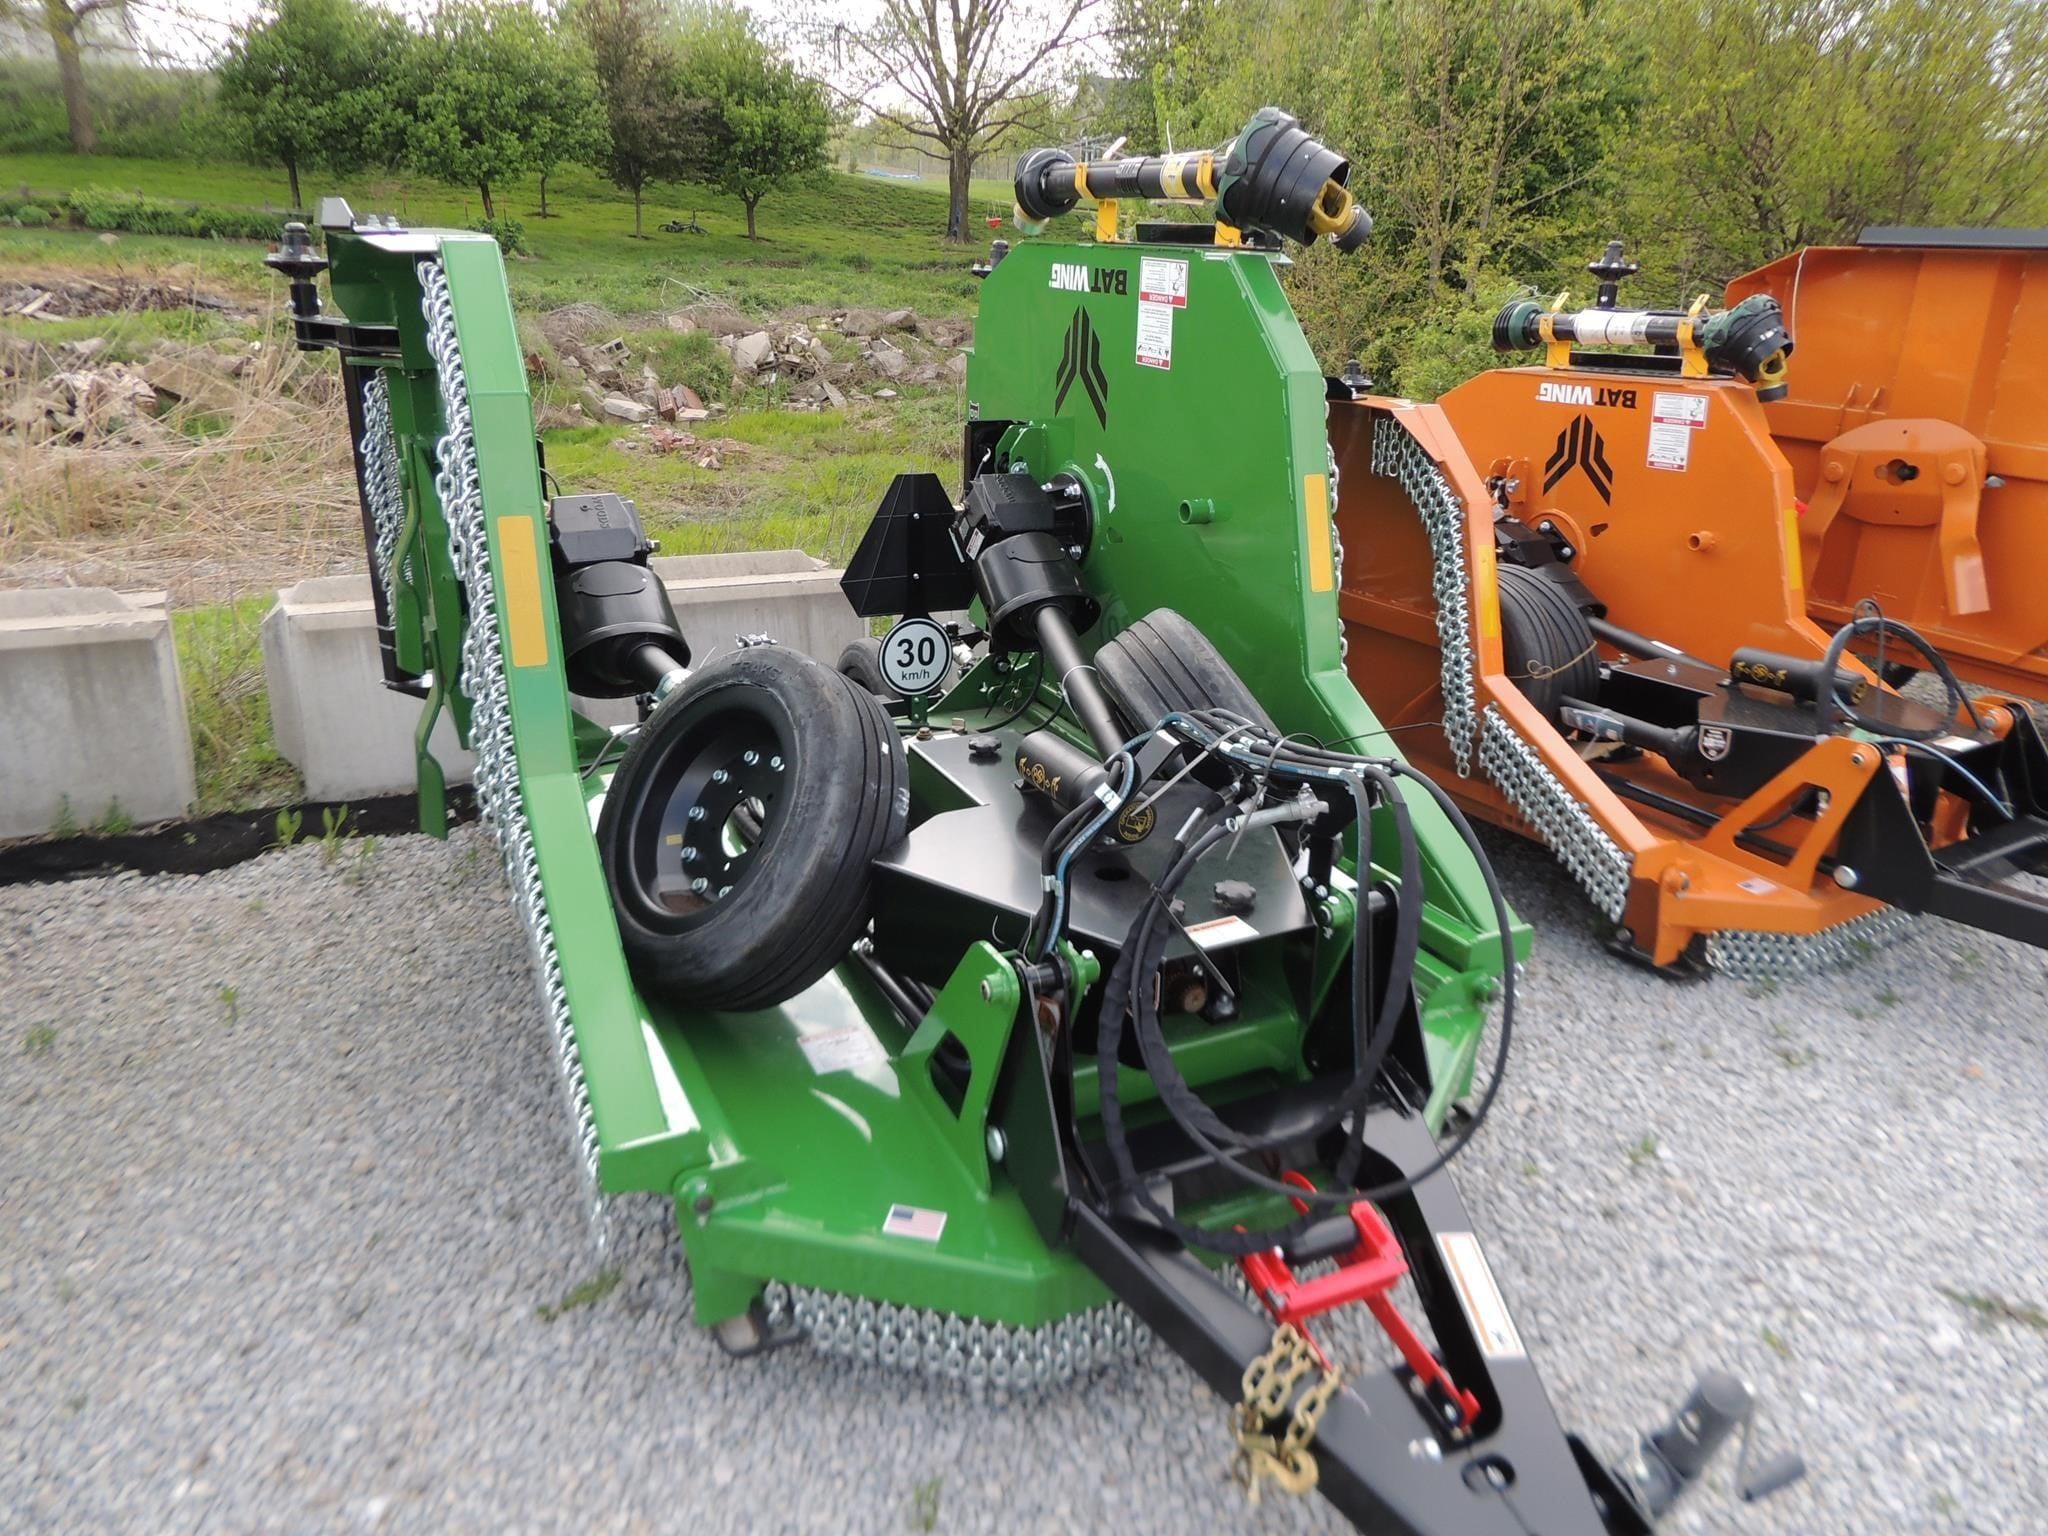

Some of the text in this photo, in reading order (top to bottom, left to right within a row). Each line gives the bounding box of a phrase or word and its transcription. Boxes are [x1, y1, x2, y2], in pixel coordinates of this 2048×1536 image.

[1050, 263, 1090, 293] WING
[1090, 268, 1128, 295] BAT
[1538, 382, 1595, 406] WING
[1594, 388, 1637, 409] BAT
[896, 636, 936, 668] 30
[901, 668, 931, 681] km/h
